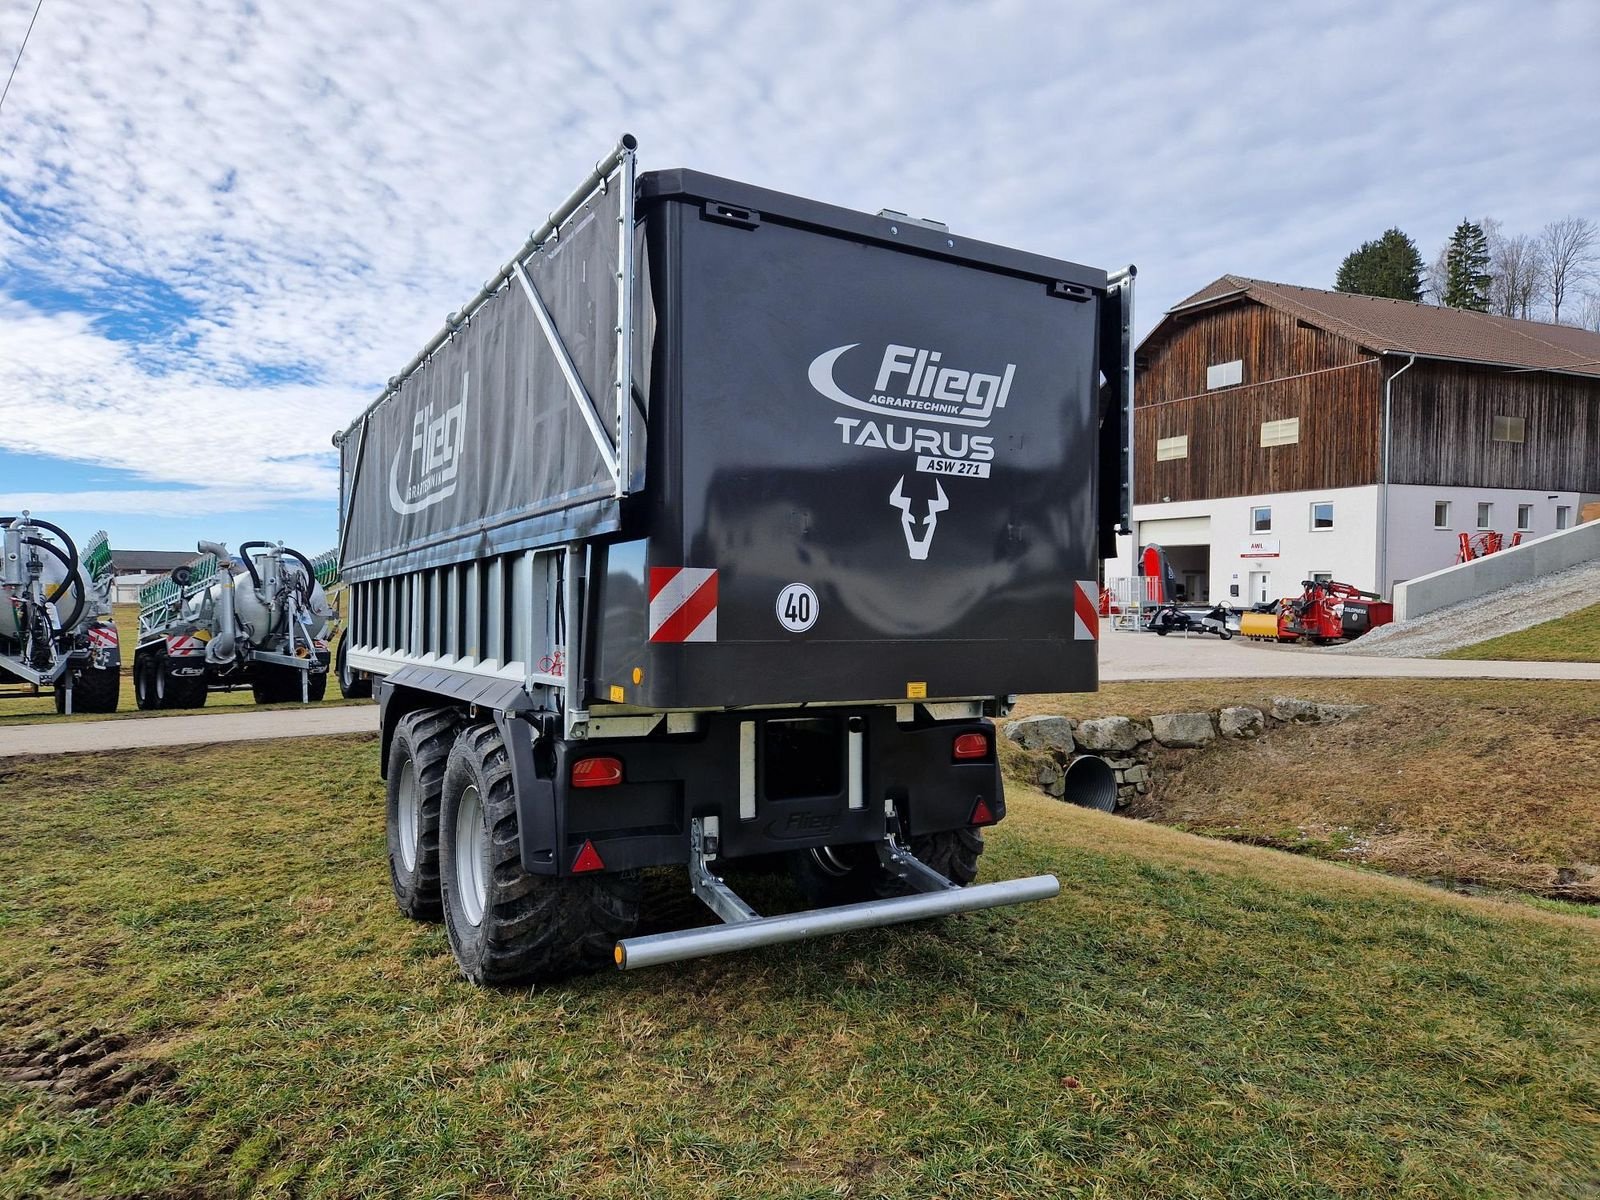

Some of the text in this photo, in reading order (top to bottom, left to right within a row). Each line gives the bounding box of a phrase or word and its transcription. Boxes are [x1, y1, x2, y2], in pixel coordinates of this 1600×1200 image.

[874, 344, 1017, 418] Fliegl
[868, 394, 960, 414] AGRARTECHNIK
[408, 371, 469, 482] Fliegl
[833, 416, 995, 461] TAURUS
[927, 459, 981, 475] ASW 271
[785, 593, 810, 622] 40
